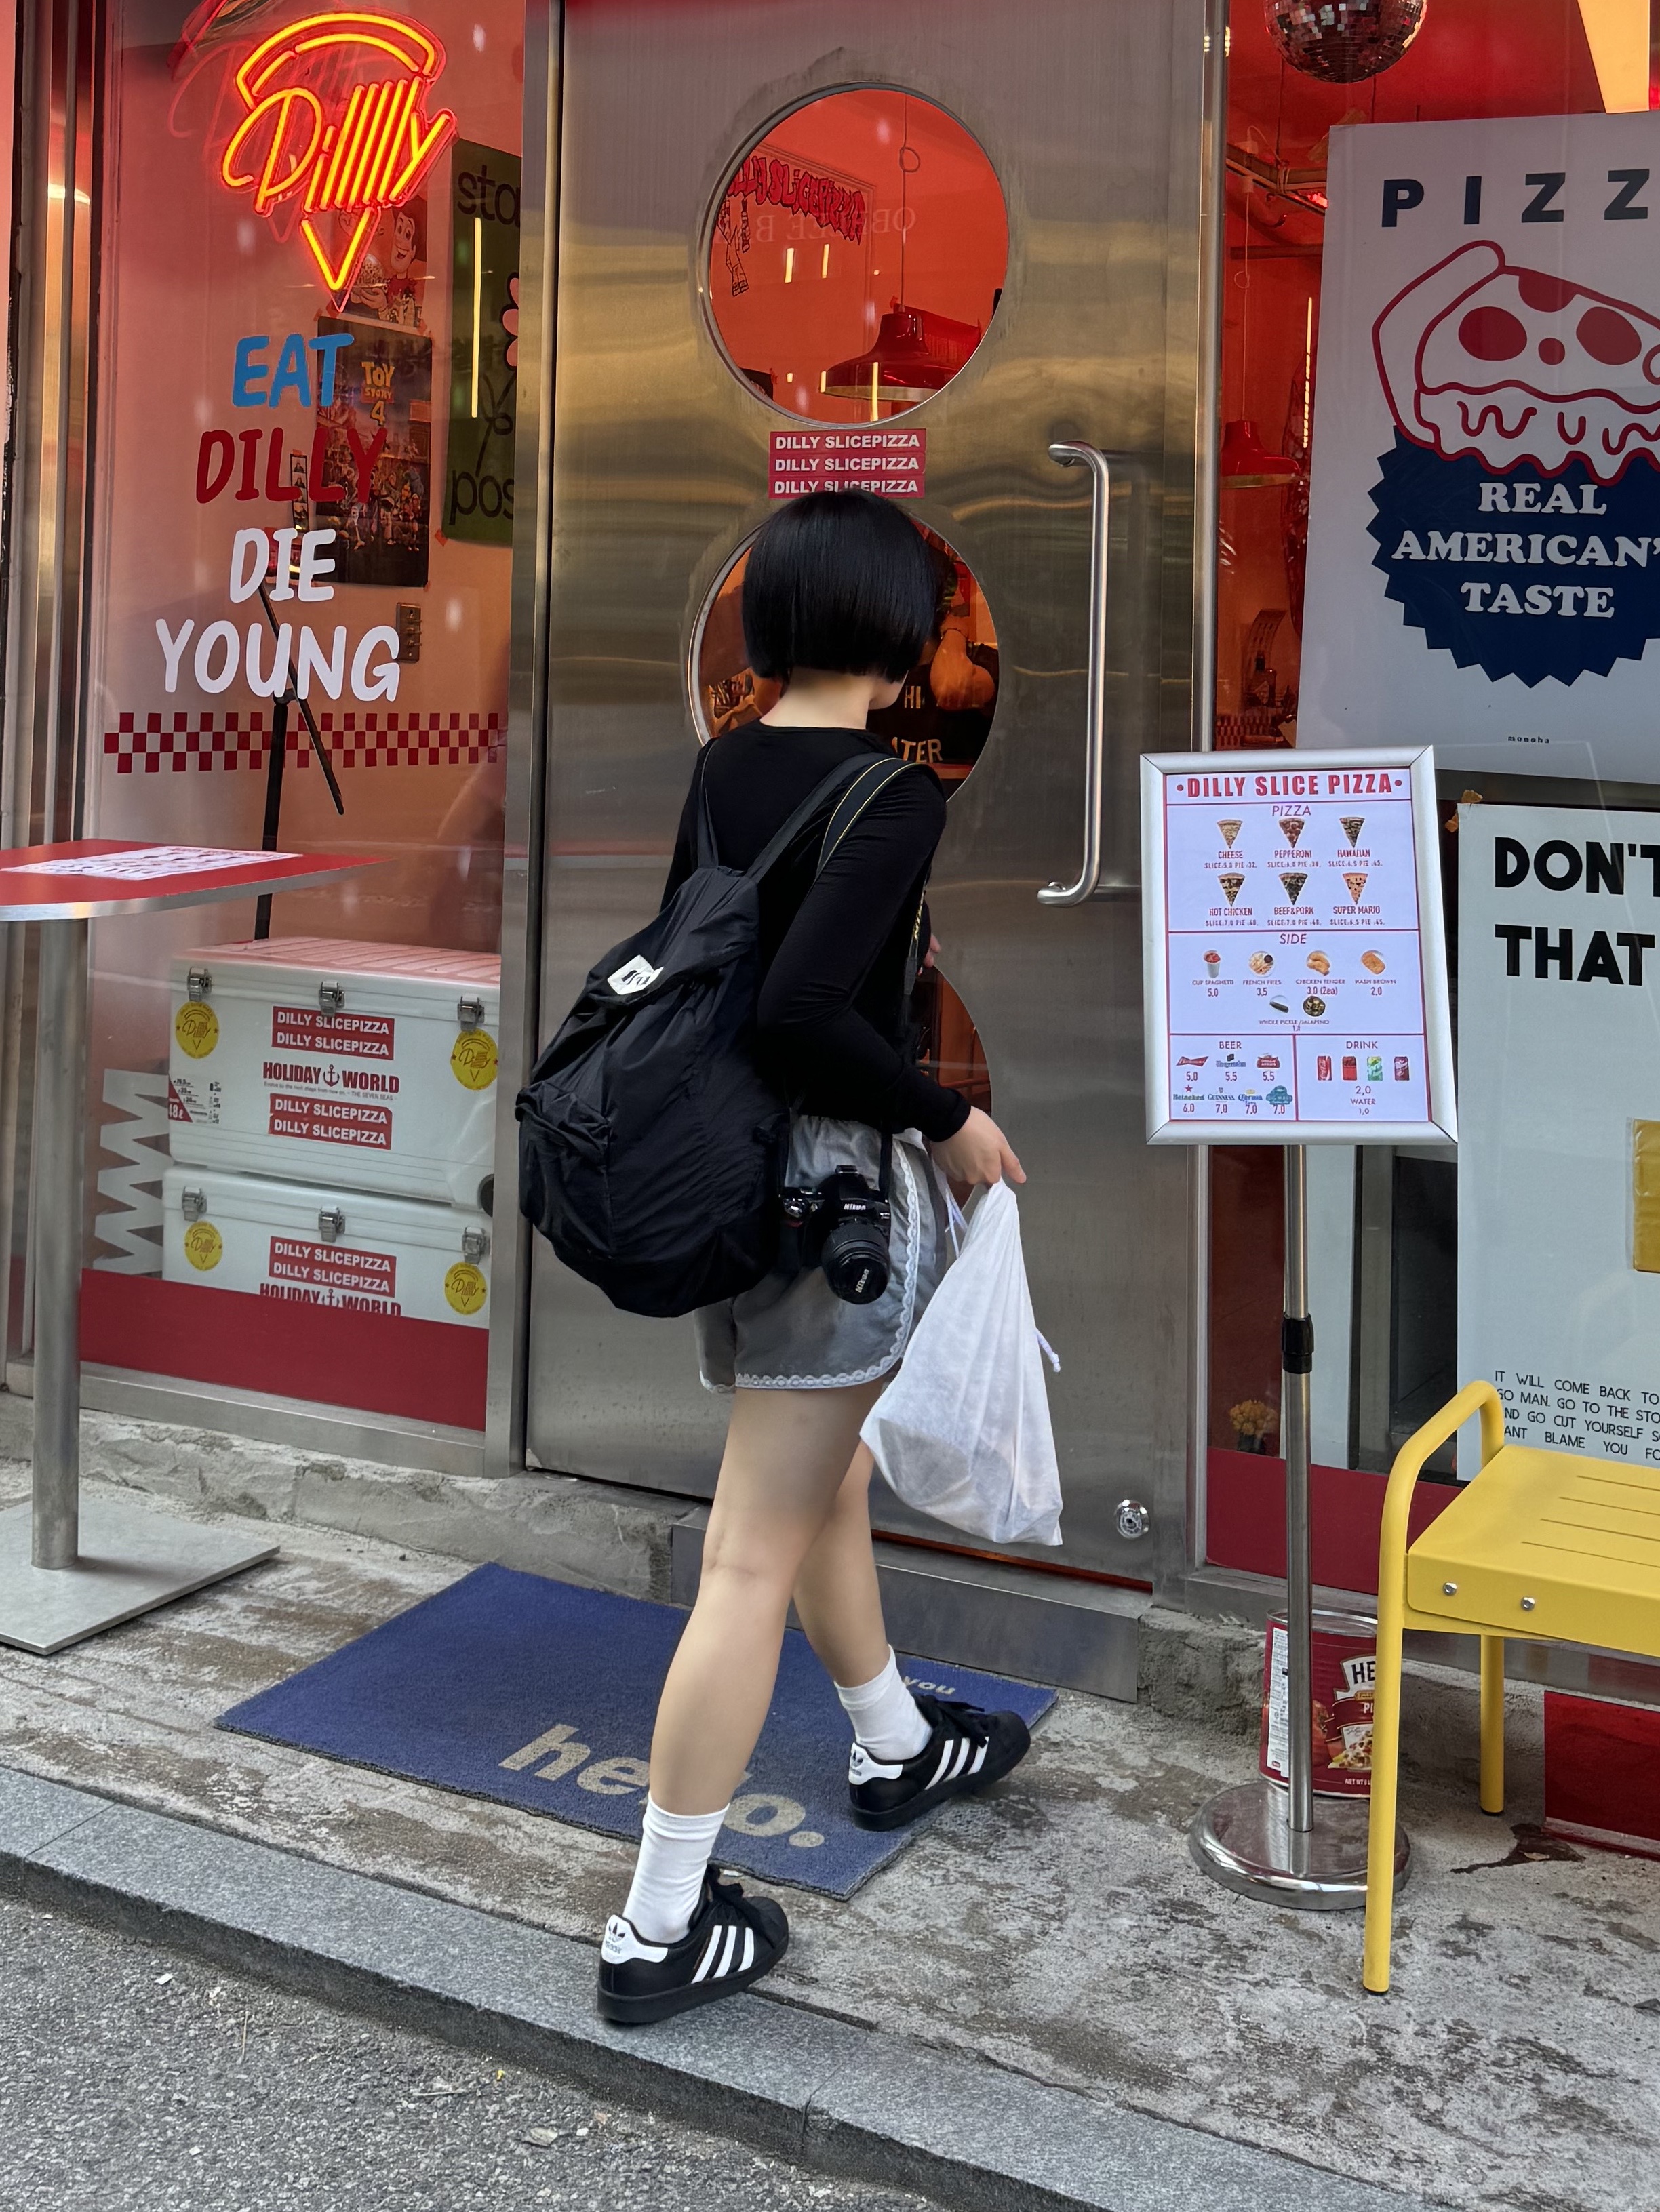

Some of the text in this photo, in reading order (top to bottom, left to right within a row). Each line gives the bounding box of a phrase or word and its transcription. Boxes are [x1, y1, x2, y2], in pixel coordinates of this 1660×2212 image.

[233, 333, 355, 408] EAT
[361, 361, 395, 388] TOY
[365, 387, 392, 399] STORY
[370, 400, 386, 426] 4
[776, 434, 920, 449] DILLY SLICEPIZZA
[197, 427, 388, 504] DILLY
[775, 457, 919, 472] DILLY SLICEPIZZA
[774, 481, 819, 494] DILLY
[1478, 482, 1607, 515] REAL
[230, 527, 336, 604] DIE
[1460, 582, 1615, 618] TASTE
[155, 618, 401, 702] YOUNG
[1507, 735, 1550, 744] monoha
[1187, 773, 1392, 797] DILLY SLICE PIZZA
[1272, 805, 1312, 816] PIZZA
[1219, 851, 1244, 859] CHEESE
[1274, 849, 1312, 858] PEPPERONI
[1209, 907, 1253, 916] HOT CHICKEN
[1274, 906, 1314, 915] BEEF&PORK
[1332, 906, 1381, 914] SUPER MARIO
[1280, 933, 1307, 944] SIDE
[1495, 924, 1655, 986] THAT
[1208, 988, 1219, 997] 5.0
[1257, 987, 1267, 997] 3.5
[1370, 986, 1383, 996] 2.0
[277, 1011, 389, 1035] DILLY SLICEPIZZA
[277, 1032, 389, 1056] DILLY SLICEPIZZA
[1219, 1041, 1242, 1049] BEER
[1346, 1041, 1378, 1049] DRINK
[263, 1061, 400, 1093] HOLIDAY WORLD
[1186, 1071, 1198, 1081] 5.0
[1225, 1071, 1238, 1081] 5.5
[1263, 1071, 1275, 1081] 5.5
[275, 1099, 387, 1125] DILLY SLICEPIZZA
[1183, 1103, 1195, 1113] 6.0
[1216, 1104, 1228, 1114] 7.0
[274, 1119, 387, 1146] DILLY SLICEPIZZA
[844, 1203, 866, 1211] Nikon
[275, 1242, 391, 1272] DILLY SLICEPIZZA
[273, 1262, 390, 1293] DILLY SLICEPIZZA
[1495, 1370, 1660, 1405] IT WILL COME BACK TO
[1557, 1398, 1576, 1410] GO
[1582, 1401, 1600, 1414] TO
[1606, 1405, 1629, 1419] THE
[1527, 1411, 1546, 1423] GO
[1553, 1415, 1577, 1428] CUT
[1584, 1419, 1644, 1439] YOURSELF
[1545, 1431, 1585, 1449] BLAME
[1603, 1441, 1628, 1455] YOU
[498, 1723, 825, 1854] heo.
